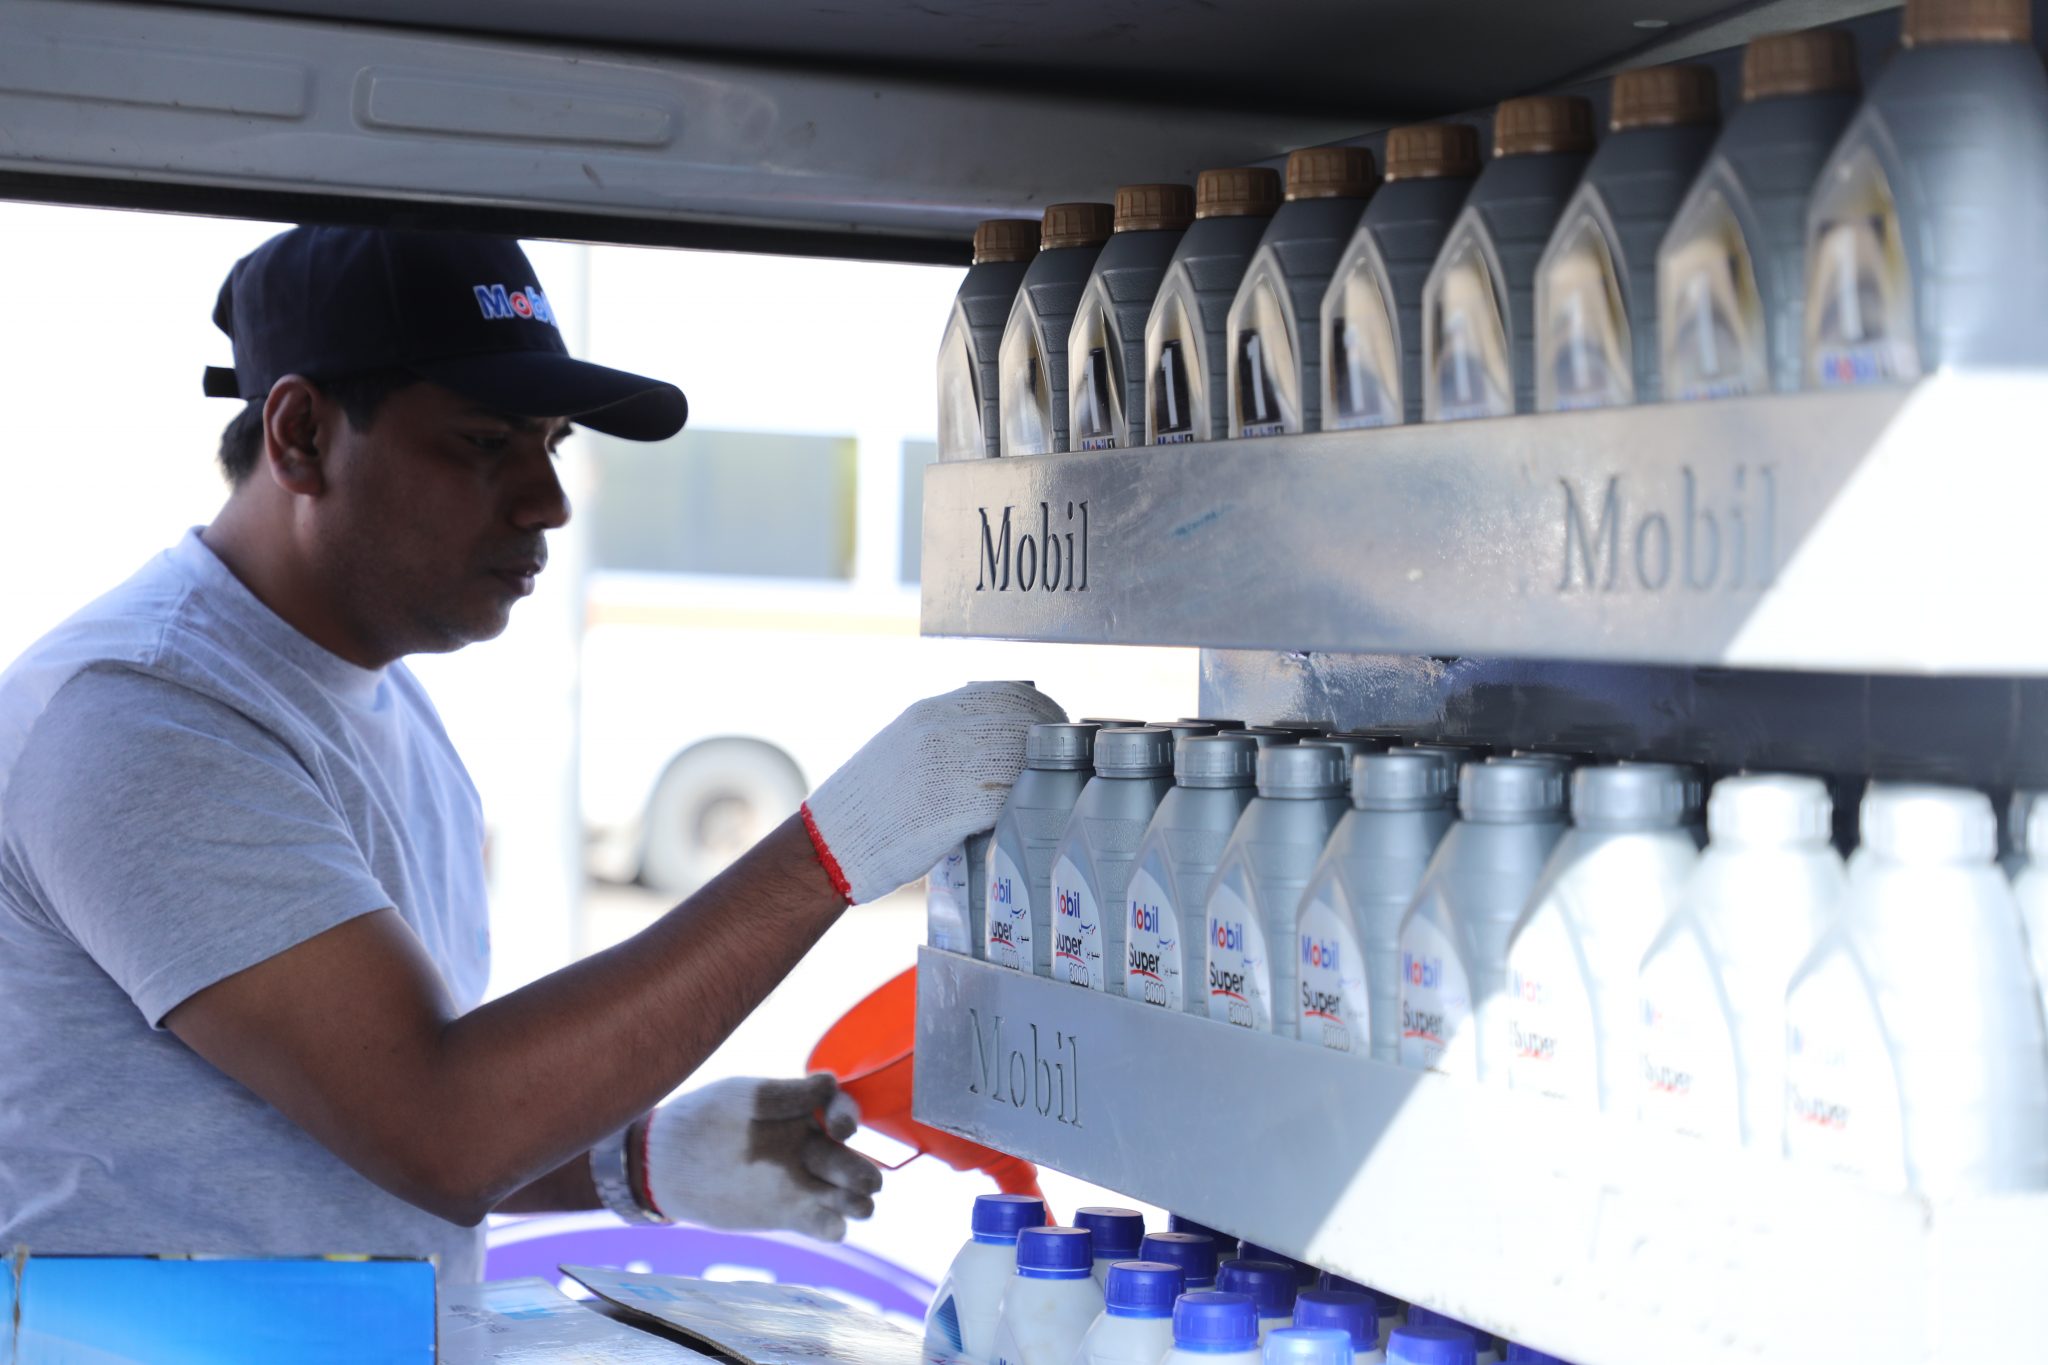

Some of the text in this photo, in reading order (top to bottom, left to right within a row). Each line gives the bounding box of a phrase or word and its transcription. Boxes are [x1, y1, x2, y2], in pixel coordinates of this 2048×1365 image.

[1082, 355, 1101, 433] 1
[1161, 347, 1179, 429] 1
[1246, 333, 1268, 421] 1
[1557, 462, 1780, 592] Mobil
[975, 499, 1091, 593] Mobil
[992, 876, 1012, 905] obil
[992, 919, 1013, 943] uper
[1210, 917, 1244, 952] Mobil
[1128, 941, 1160, 977] Super
[1302, 934, 1340, 971] Mobil
[1403, 952, 1443, 989] Mobil
[1069, 961, 1089, 988] 3000
[1209, 960, 1245, 997] Super
[1144, 980, 1166, 1007] 3000
[1302, 980, 1342, 1016] Super
[1402, 1000, 1443, 1037] Super
[967, 1006, 1083, 1129] Mobil
